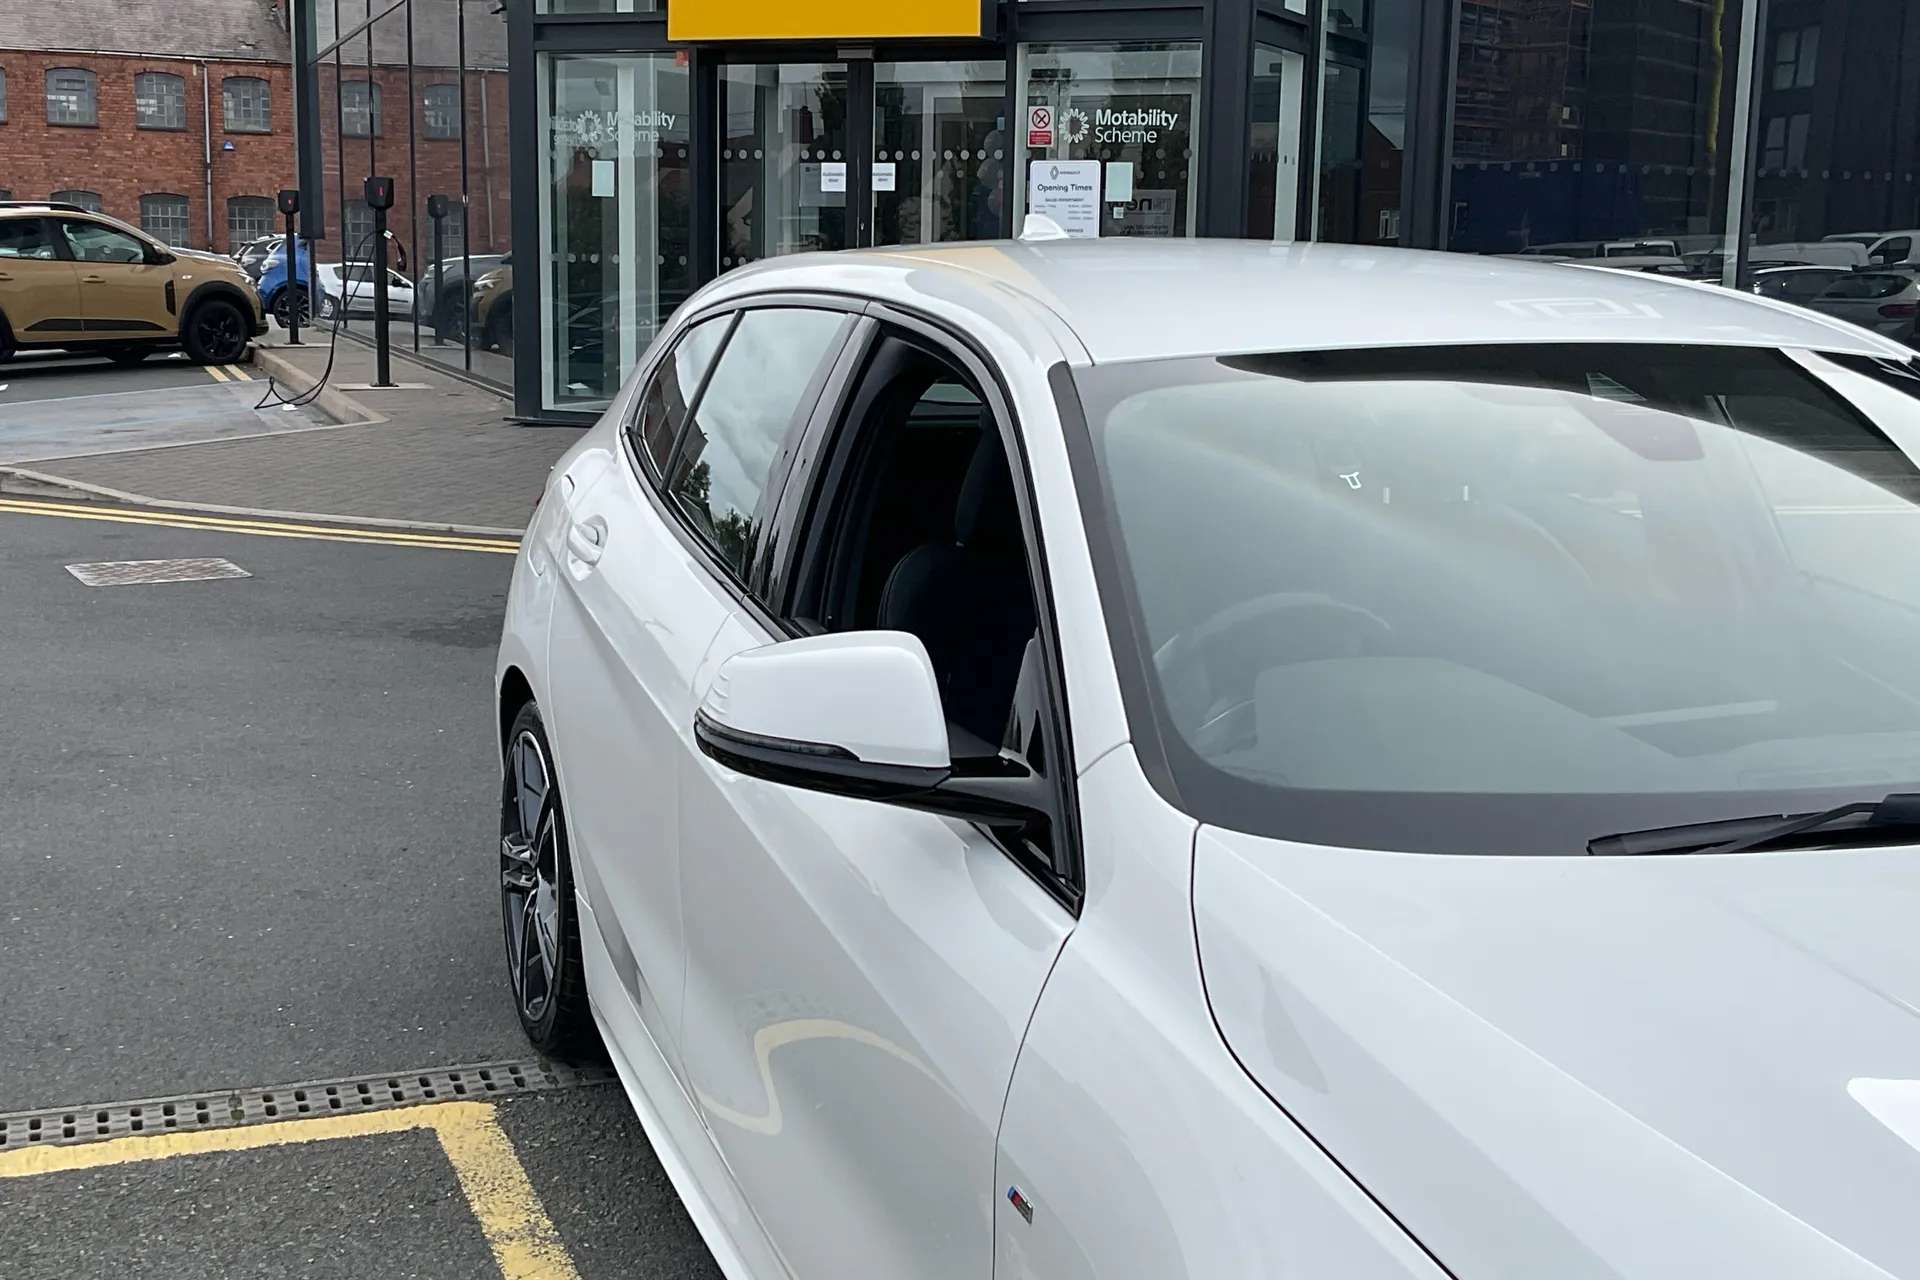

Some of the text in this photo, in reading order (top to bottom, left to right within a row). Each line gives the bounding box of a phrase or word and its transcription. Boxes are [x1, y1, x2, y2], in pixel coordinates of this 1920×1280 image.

[606, 110, 676, 130] Mability
[1095, 109, 1178, 130] Motability
[606, 127, 660, 142] Seme
[1095, 127, 1157, 143] Scheme
[1037, 183, 1093, 193] Opening Times
